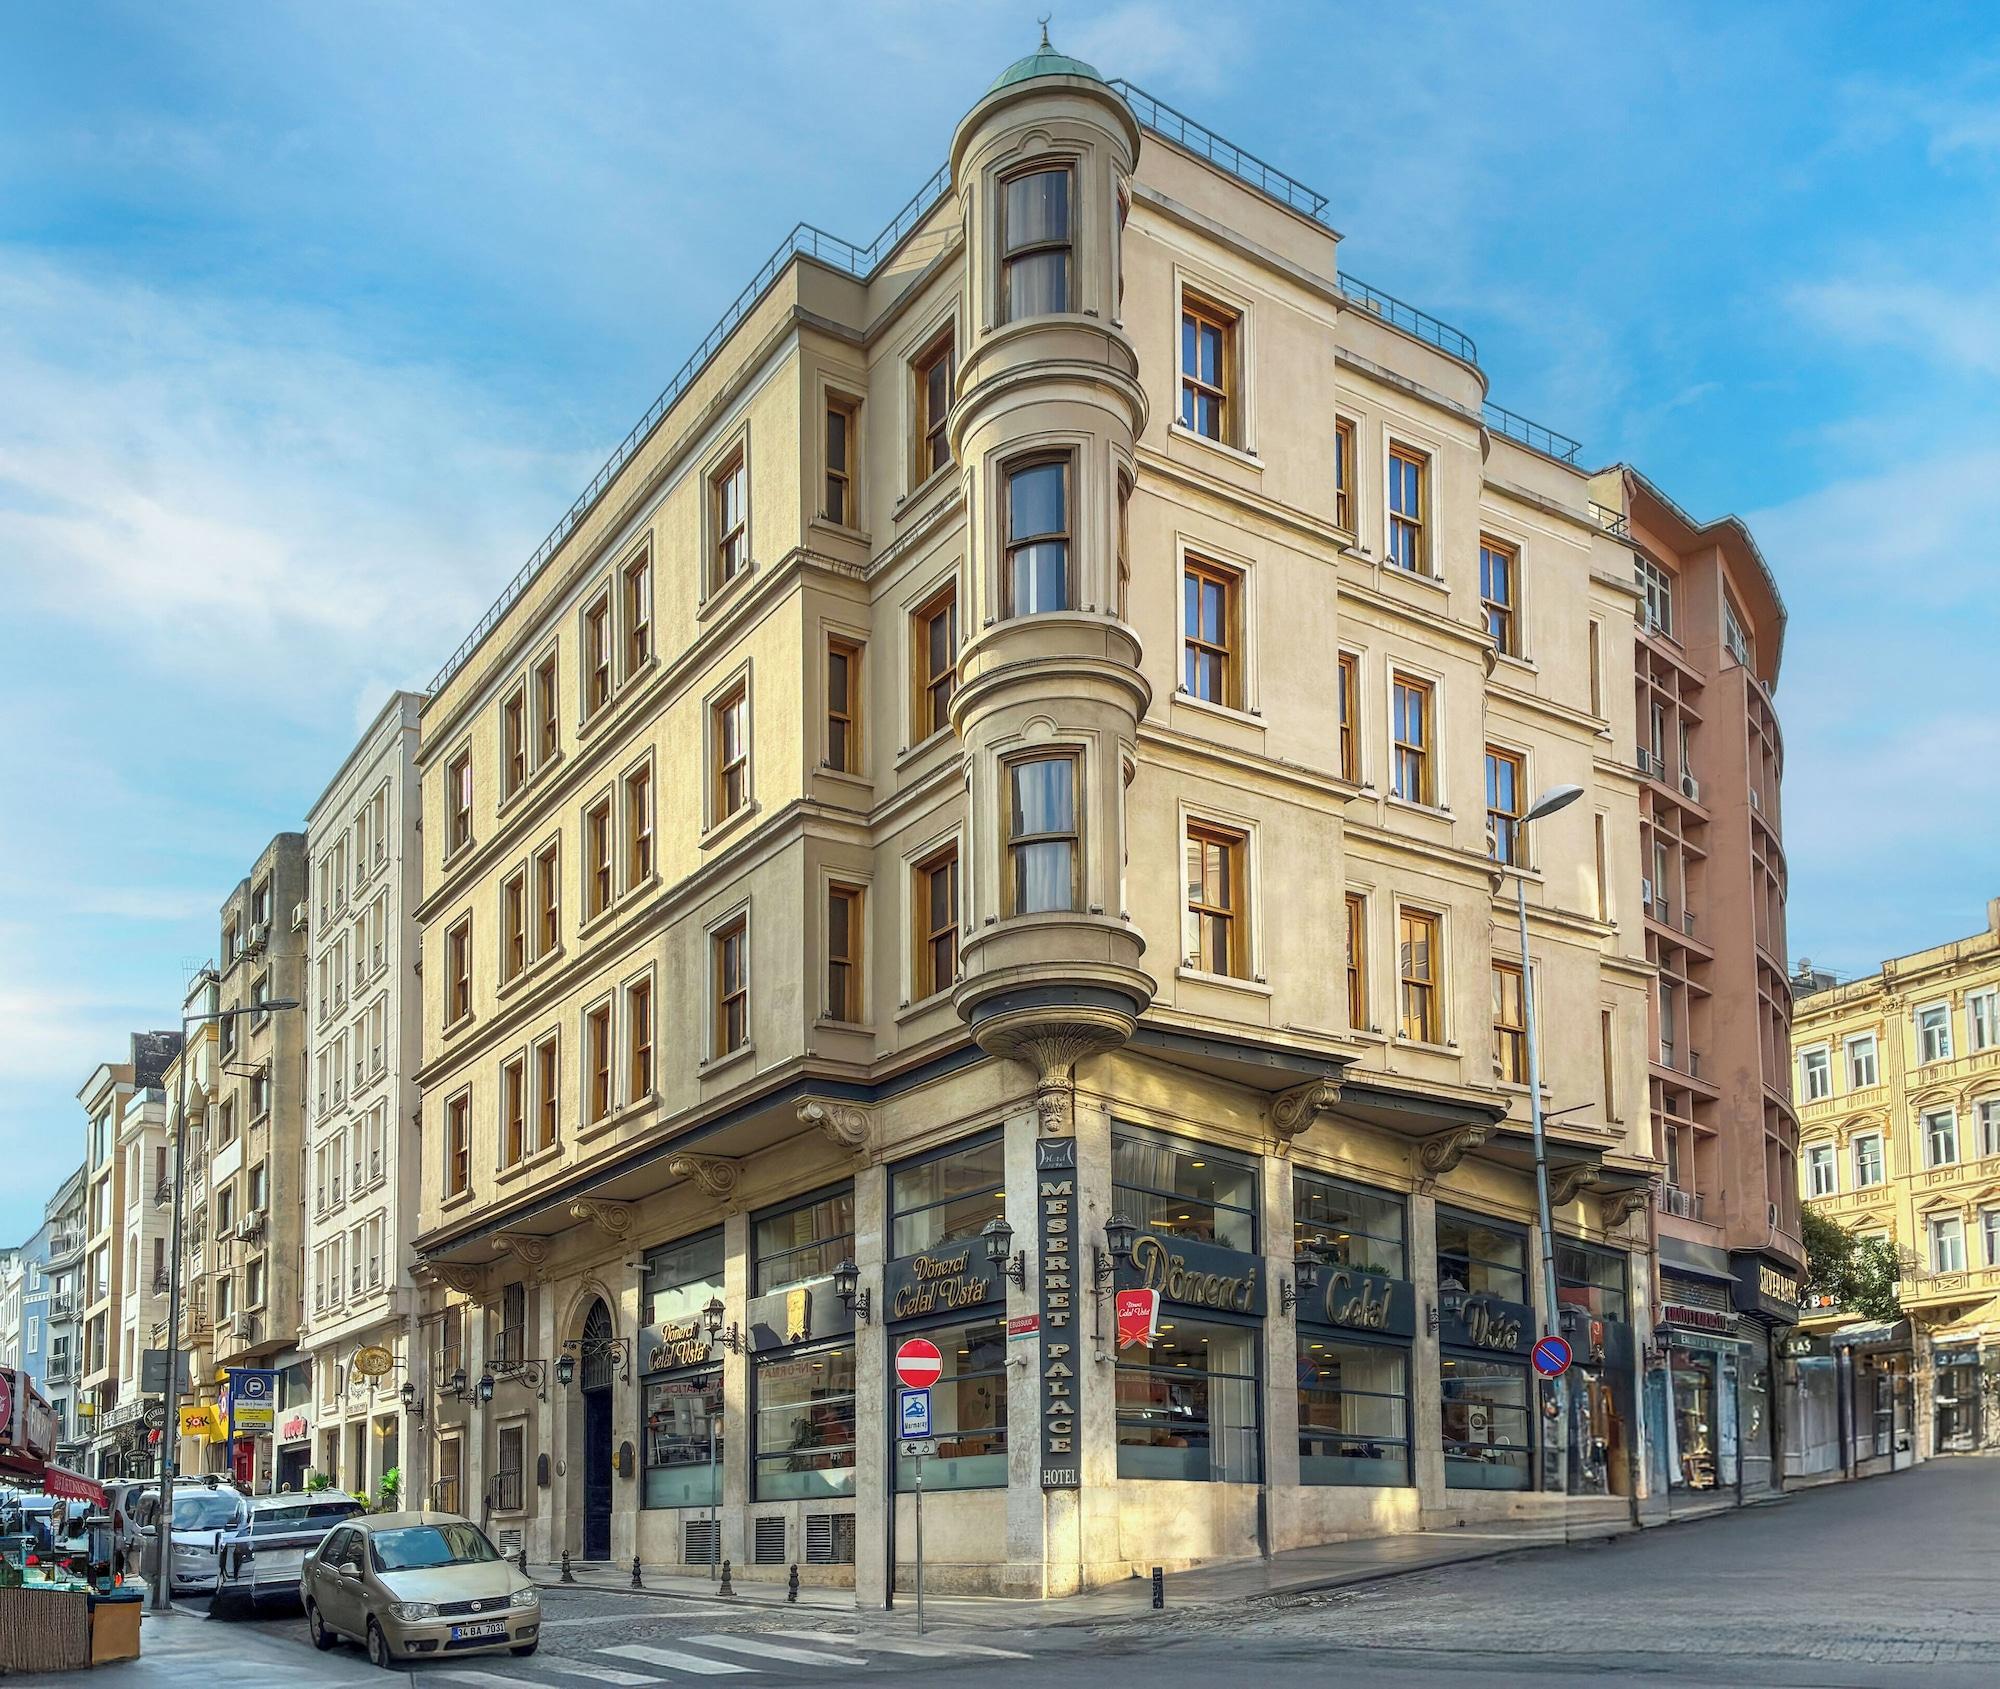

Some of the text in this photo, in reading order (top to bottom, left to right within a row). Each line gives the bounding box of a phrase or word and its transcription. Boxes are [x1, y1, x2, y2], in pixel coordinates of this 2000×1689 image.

[913, 1249, 970, 1280] Dönerci
[1040, 1180, 1072, 1326] MESERRET
[1129, 1236, 1256, 1312] Dönerci
[1326, 1271, 1392, 1329] Celal
[894, 1280, 940, 1318] Celal
[661, 1320, 699, 1343] Dönerci
[649, 1343, 676, 1371] Celal
[1045, 1343, 1074, 1453] PALACE
[1042, 1469, 1077, 1485] HOTEL
[458, 1628, 468, 1637] 34
[486, 1622, 505, 1634] 7031
